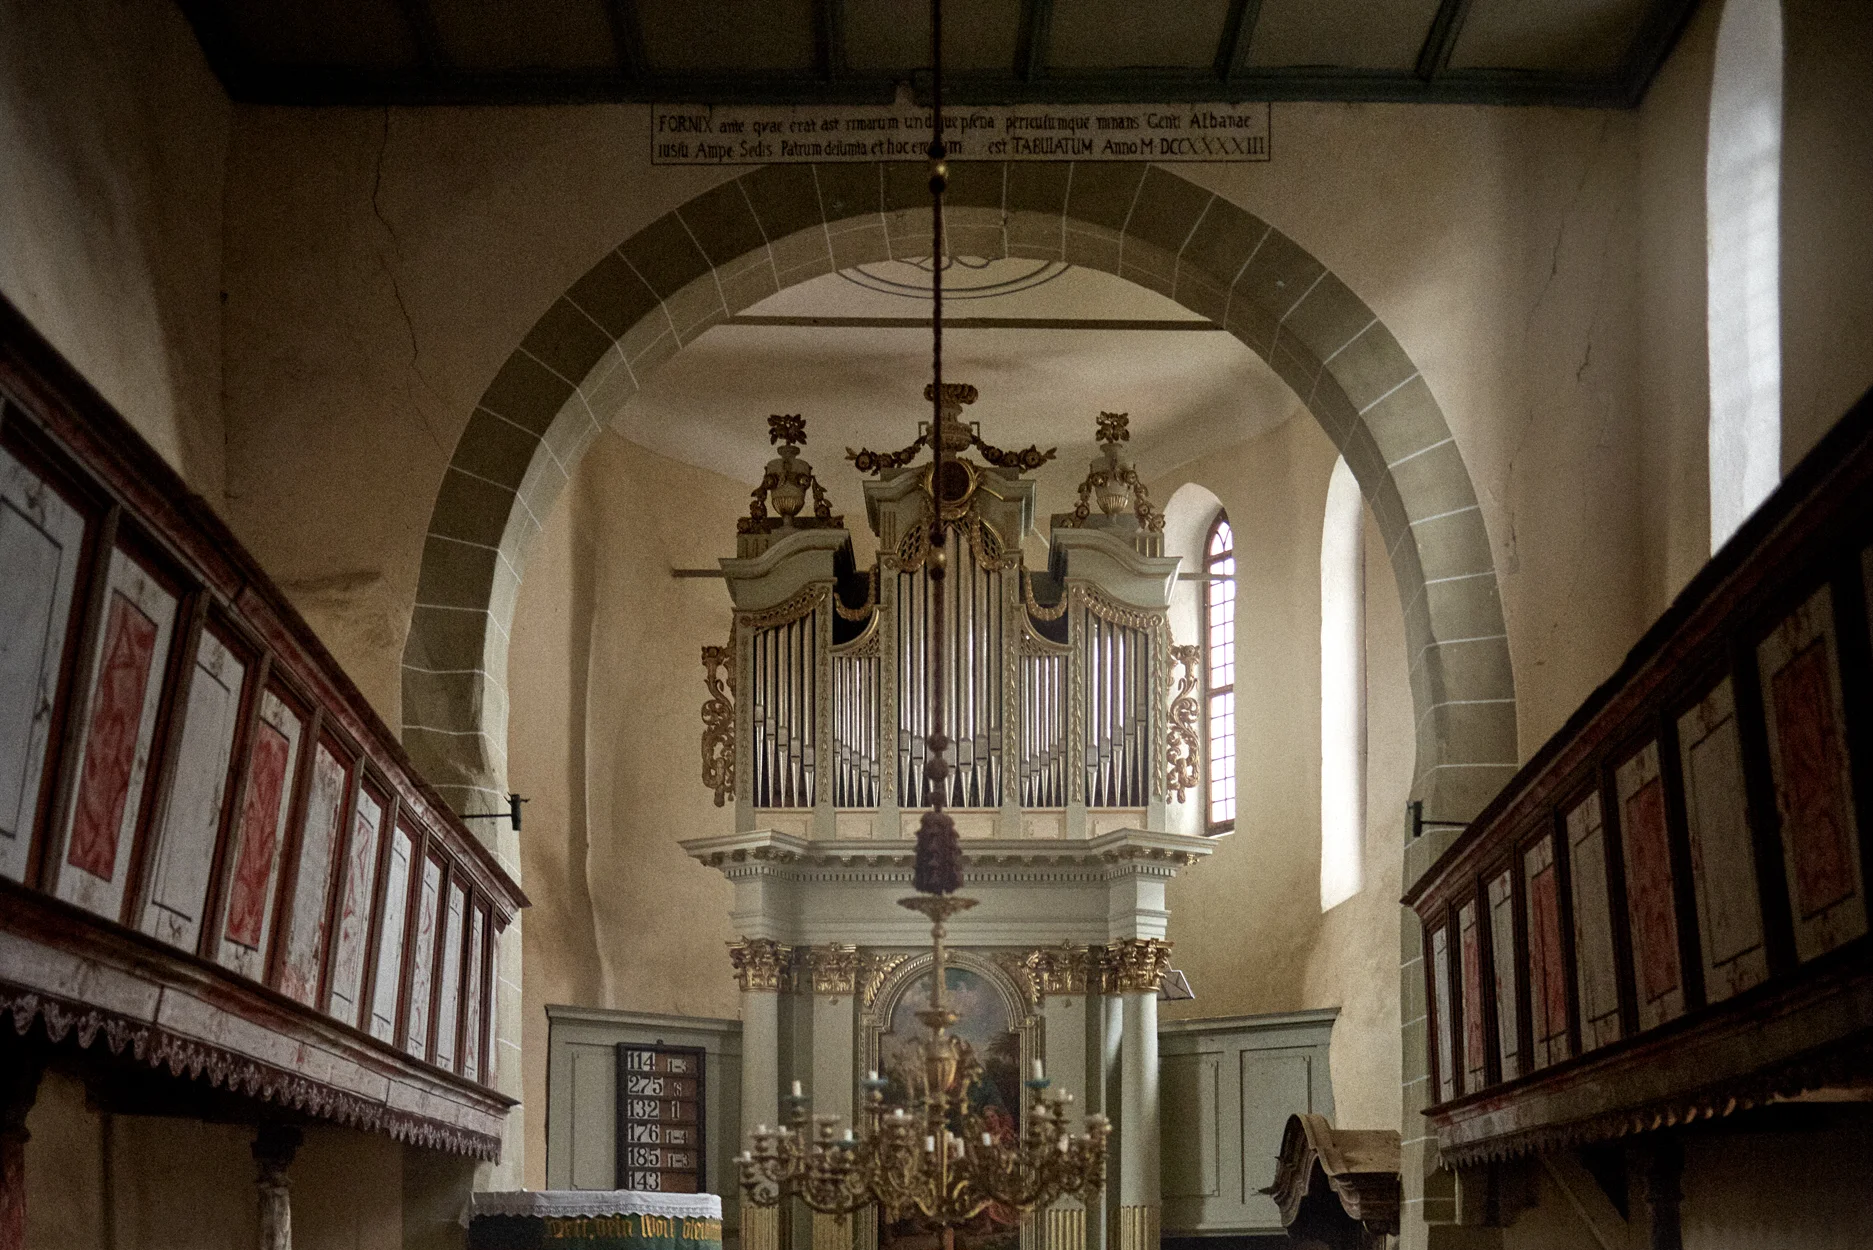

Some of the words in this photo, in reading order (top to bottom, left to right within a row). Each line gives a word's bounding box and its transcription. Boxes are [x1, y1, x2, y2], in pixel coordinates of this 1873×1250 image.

[658, 114, 713, 134] FORNIX
[719, 119, 745, 134] ante
[1189, 111, 1252, 130] Albanae
[740, 140, 773, 158] Sedis
[780, 139, 822, 157] Patrum
[871, 139, 885, 156] et
[887, 137, 909, 155] hoc
[988, 138, 1007, 155] est
[1102, 138, 1138, 155] Anno
[628, 1051, 655, 1071] 114
[628, 1074, 663, 1094] 275
[628, 1099, 660, 1119] 132
[672, 1101, 679, 1119] 1
[628, 1123, 660, 1143] 176
[628, 1147, 661, 1167] 185
[629, 1171, 661, 1191] 143
